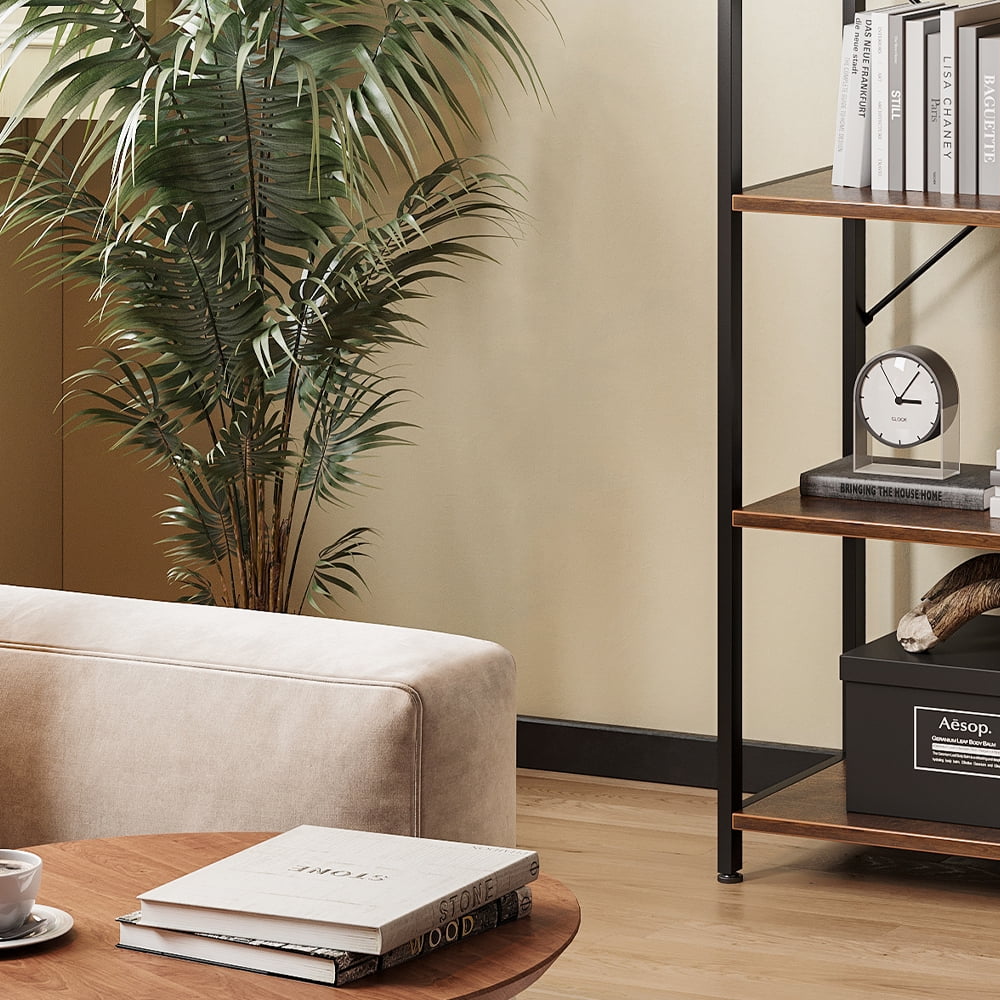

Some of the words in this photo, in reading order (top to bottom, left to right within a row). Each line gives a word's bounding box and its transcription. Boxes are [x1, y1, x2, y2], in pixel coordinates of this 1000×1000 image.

[862, 40, 871, 64] NEUE
[943, 56, 952, 90] LISA
[858, 66, 869, 118] FRANKFURT
[891, 90, 901, 120] STILL
[943, 97, 952, 160] CHANEY
[983, 74, 996, 163] BAGUETTE
[840, 483, 876, 496] BRINGING
[878, 486, 893, 497] THE
[894, 488, 920, 499] HOUSE
[920, 490, 943, 501] HOME
[288, 865, 388, 881] STONE
[440, 878, 494, 923] STONE
[410, 915, 474, 955] WOOD
